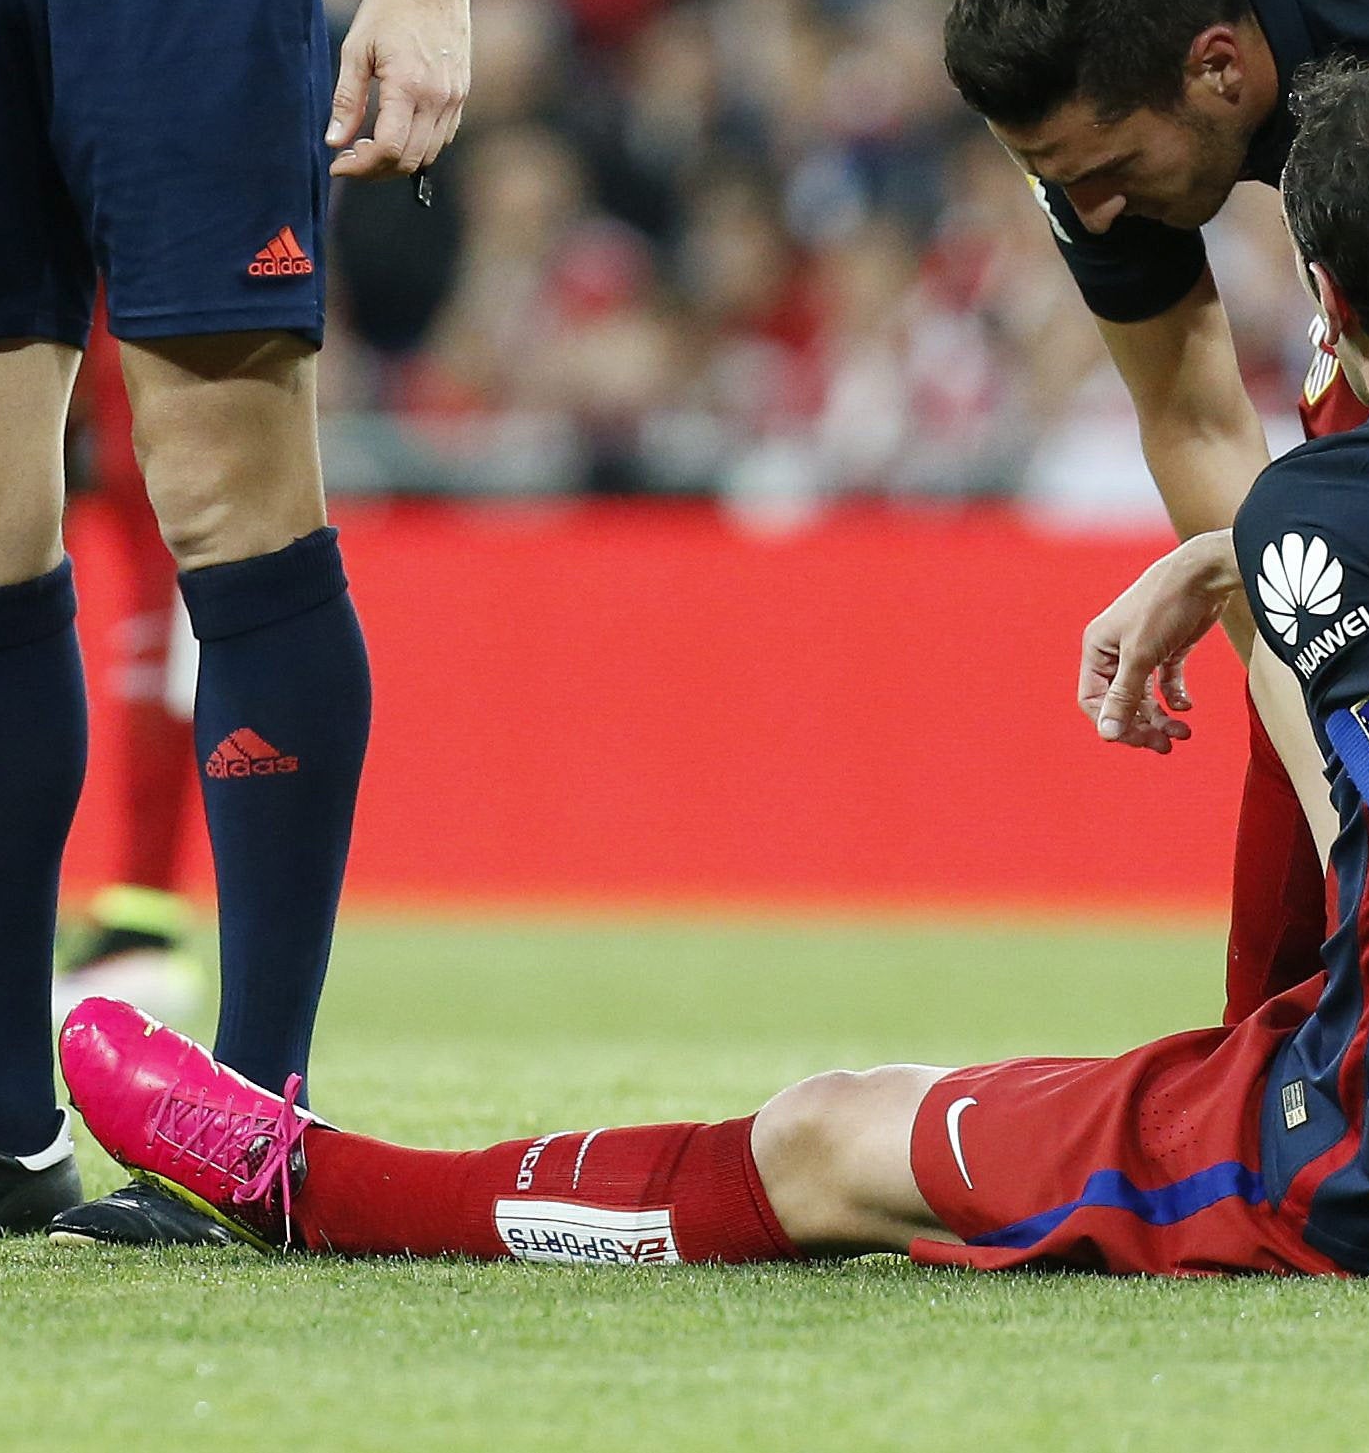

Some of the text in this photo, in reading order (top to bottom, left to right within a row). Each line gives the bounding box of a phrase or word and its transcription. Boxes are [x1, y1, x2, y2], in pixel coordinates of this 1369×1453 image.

[248, 257, 313, 276] adidas
[206, 756, 299, 778] adidas
[508, 1228, 620, 1262] SPORTS
